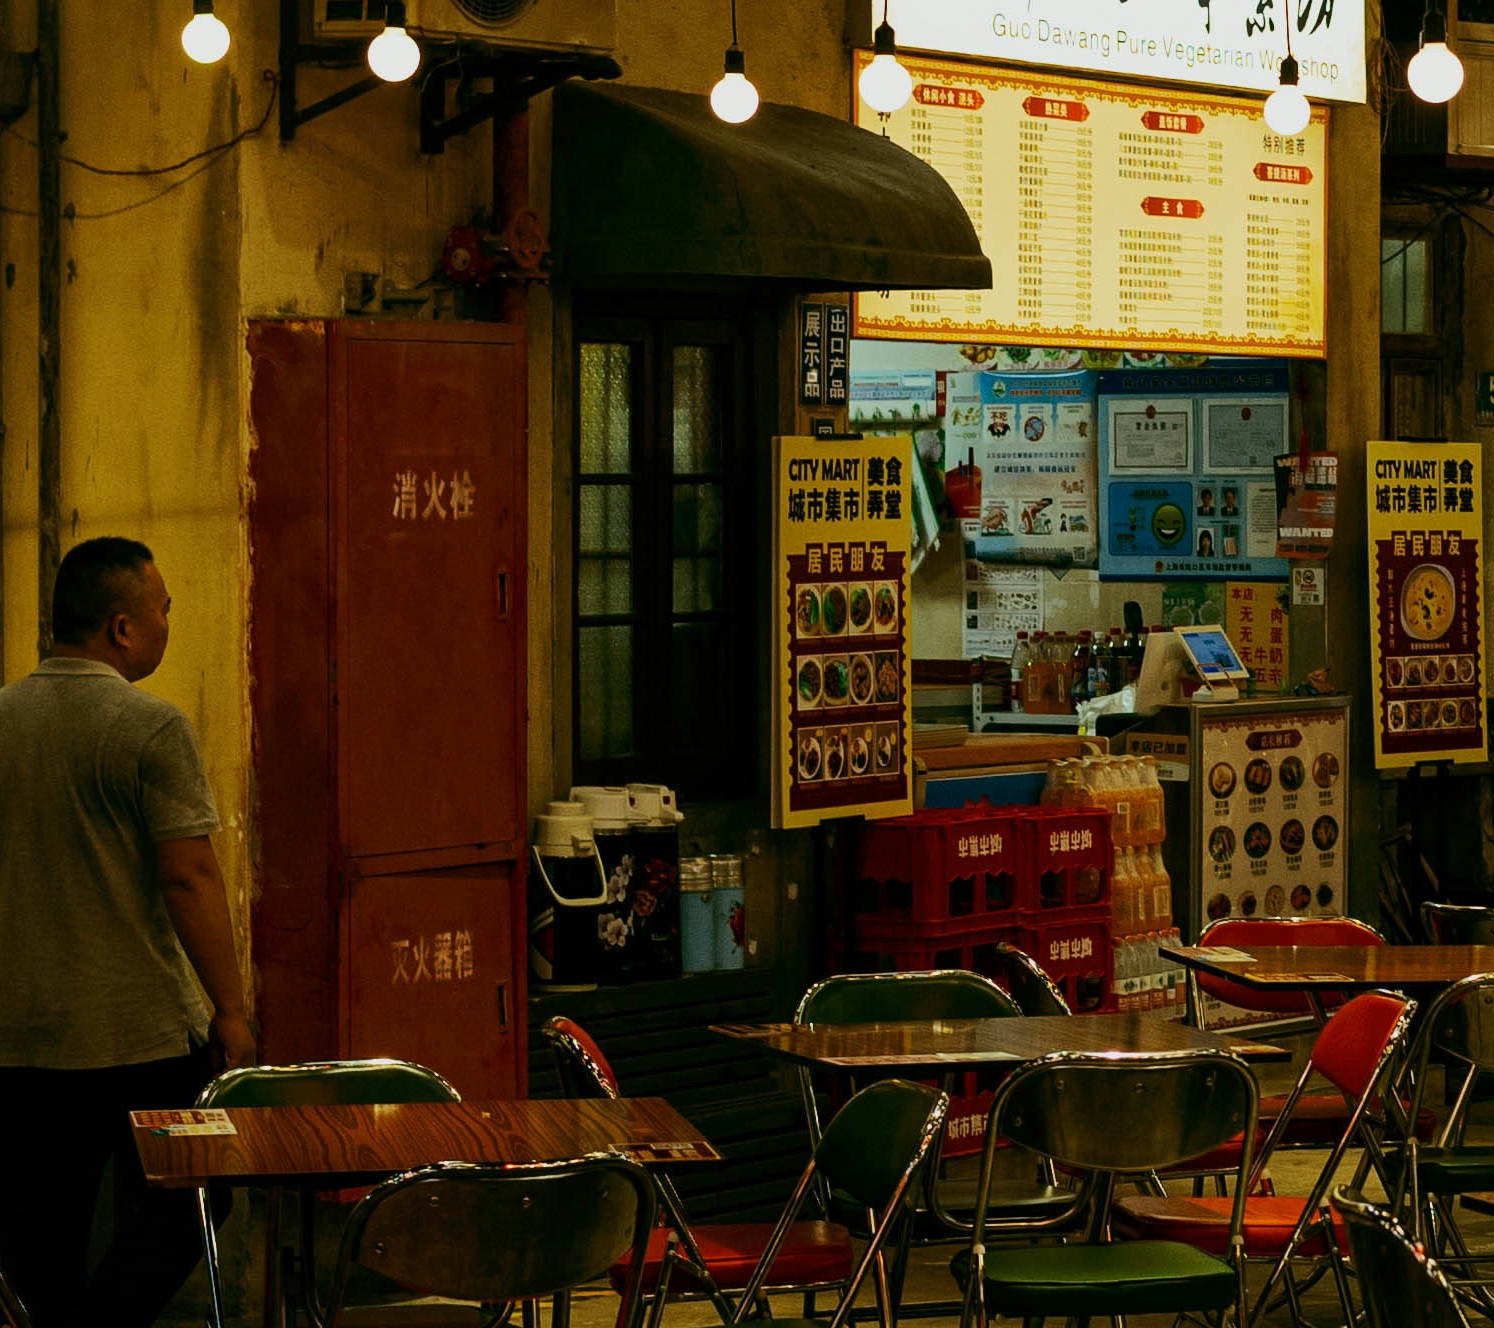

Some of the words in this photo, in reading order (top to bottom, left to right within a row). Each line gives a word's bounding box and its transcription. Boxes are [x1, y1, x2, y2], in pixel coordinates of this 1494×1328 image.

[992, 13, 1032, 41] Guo
[1038, 18, 1111, 58] Dawang
[1117, 29, 1158, 58] Pure
[1163, 36, 1255, 70] Vegetarian
[1260, 48, 1340, 81] Woshop
[804, 311, 821, 398] 展示品
[829, 308, 846, 400] 出口产品
[789, 458, 819, 482] CITY
[821, 458, 860, 481] MART
[868, 456, 902, 486] 美食
[1375, 460, 1402, 479] CITY
[1404, 459, 1437, 479] MART
[1444, 459, 1473, 484] 美食
[392, 470, 477, 521] 消火栓
[789, 488, 860, 522] 城市集市
[867, 489, 902, 519] 弄堂
[1375, 484, 1438, 514] 城市集市
[1444, 487, 1473, 513] 弄堂
[807, 545, 886, 574] 居民朋友
[1393, 534, 1461, 557] 居民朋友
[1240, 606, 1253, 623] 无
[1270, 607, 1283, 625] 肉
[1239, 626, 1253, 643] 无
[390, 929, 474, 984] 灭火器箱
